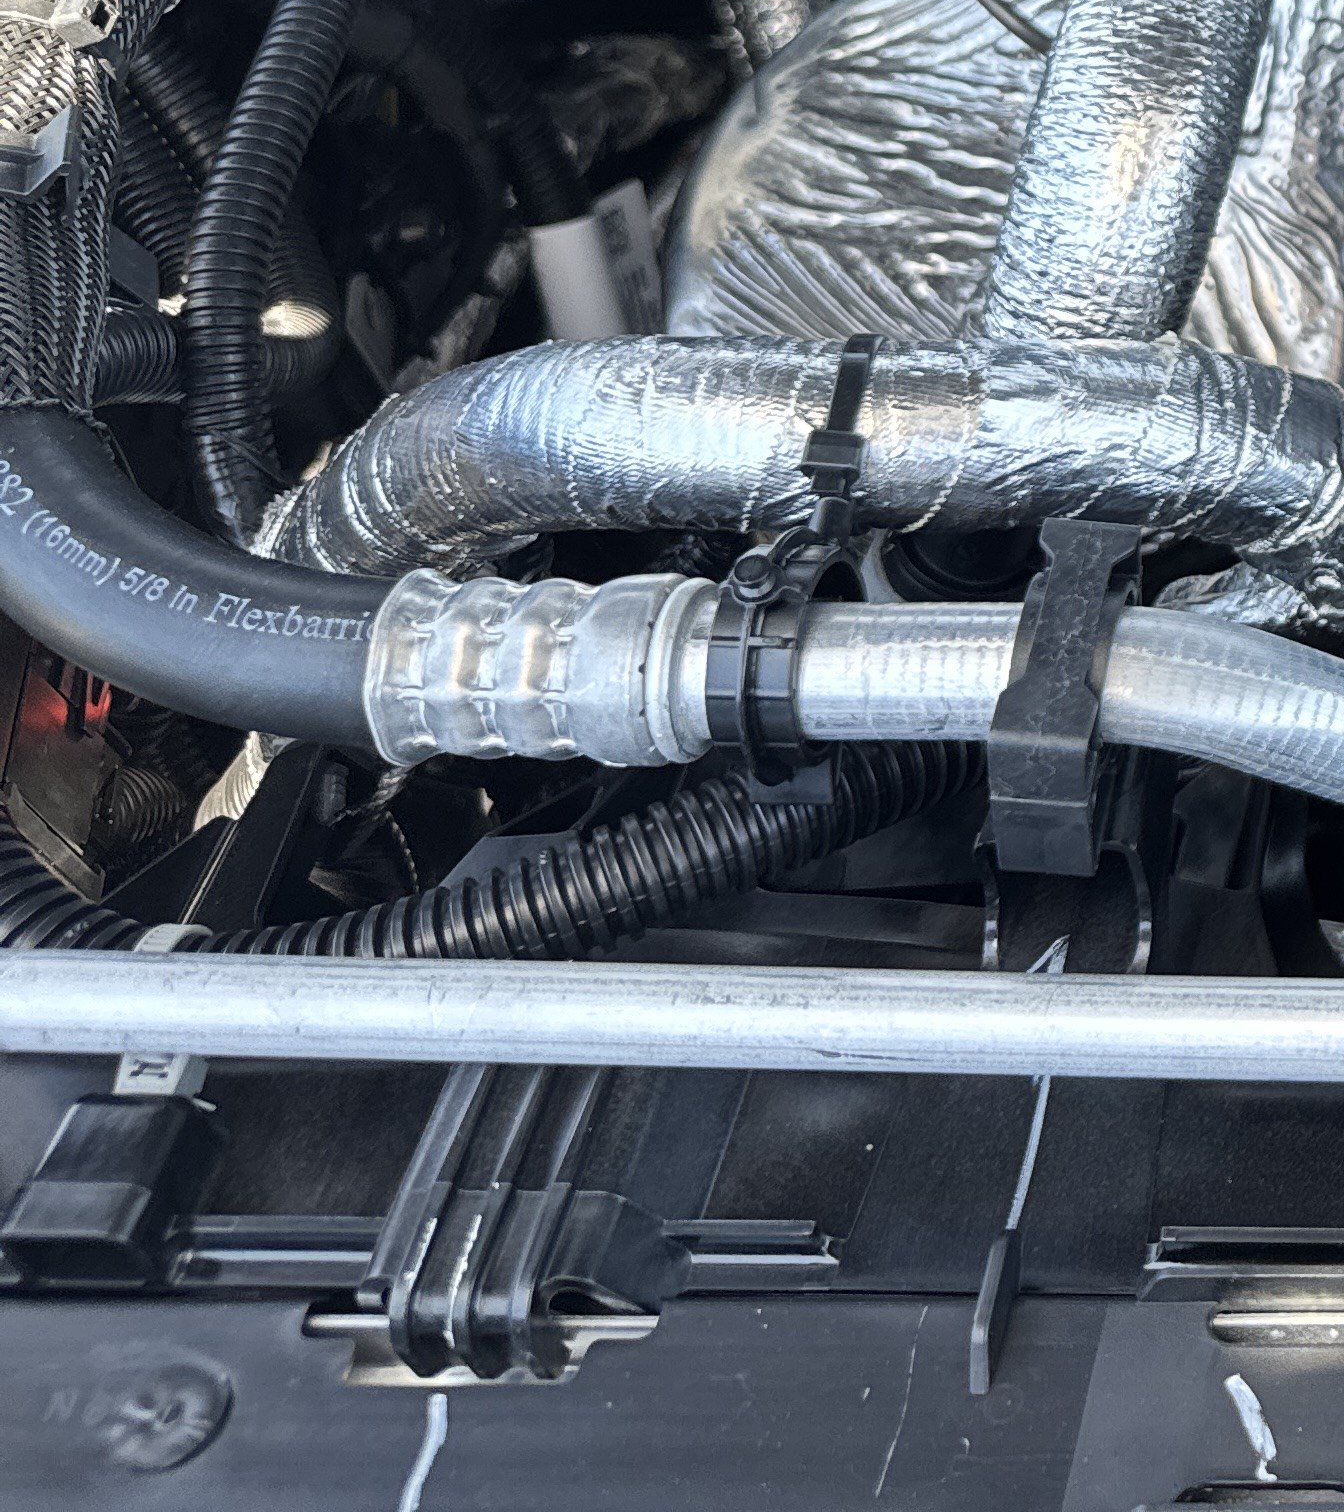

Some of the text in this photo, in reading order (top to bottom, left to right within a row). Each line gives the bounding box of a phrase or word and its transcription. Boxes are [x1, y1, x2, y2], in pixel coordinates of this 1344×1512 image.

[20, 509, 121, 587] (16mm)
[119, 566, 169, 601] 5/8
[203, 592, 375, 641] Flexbarri
